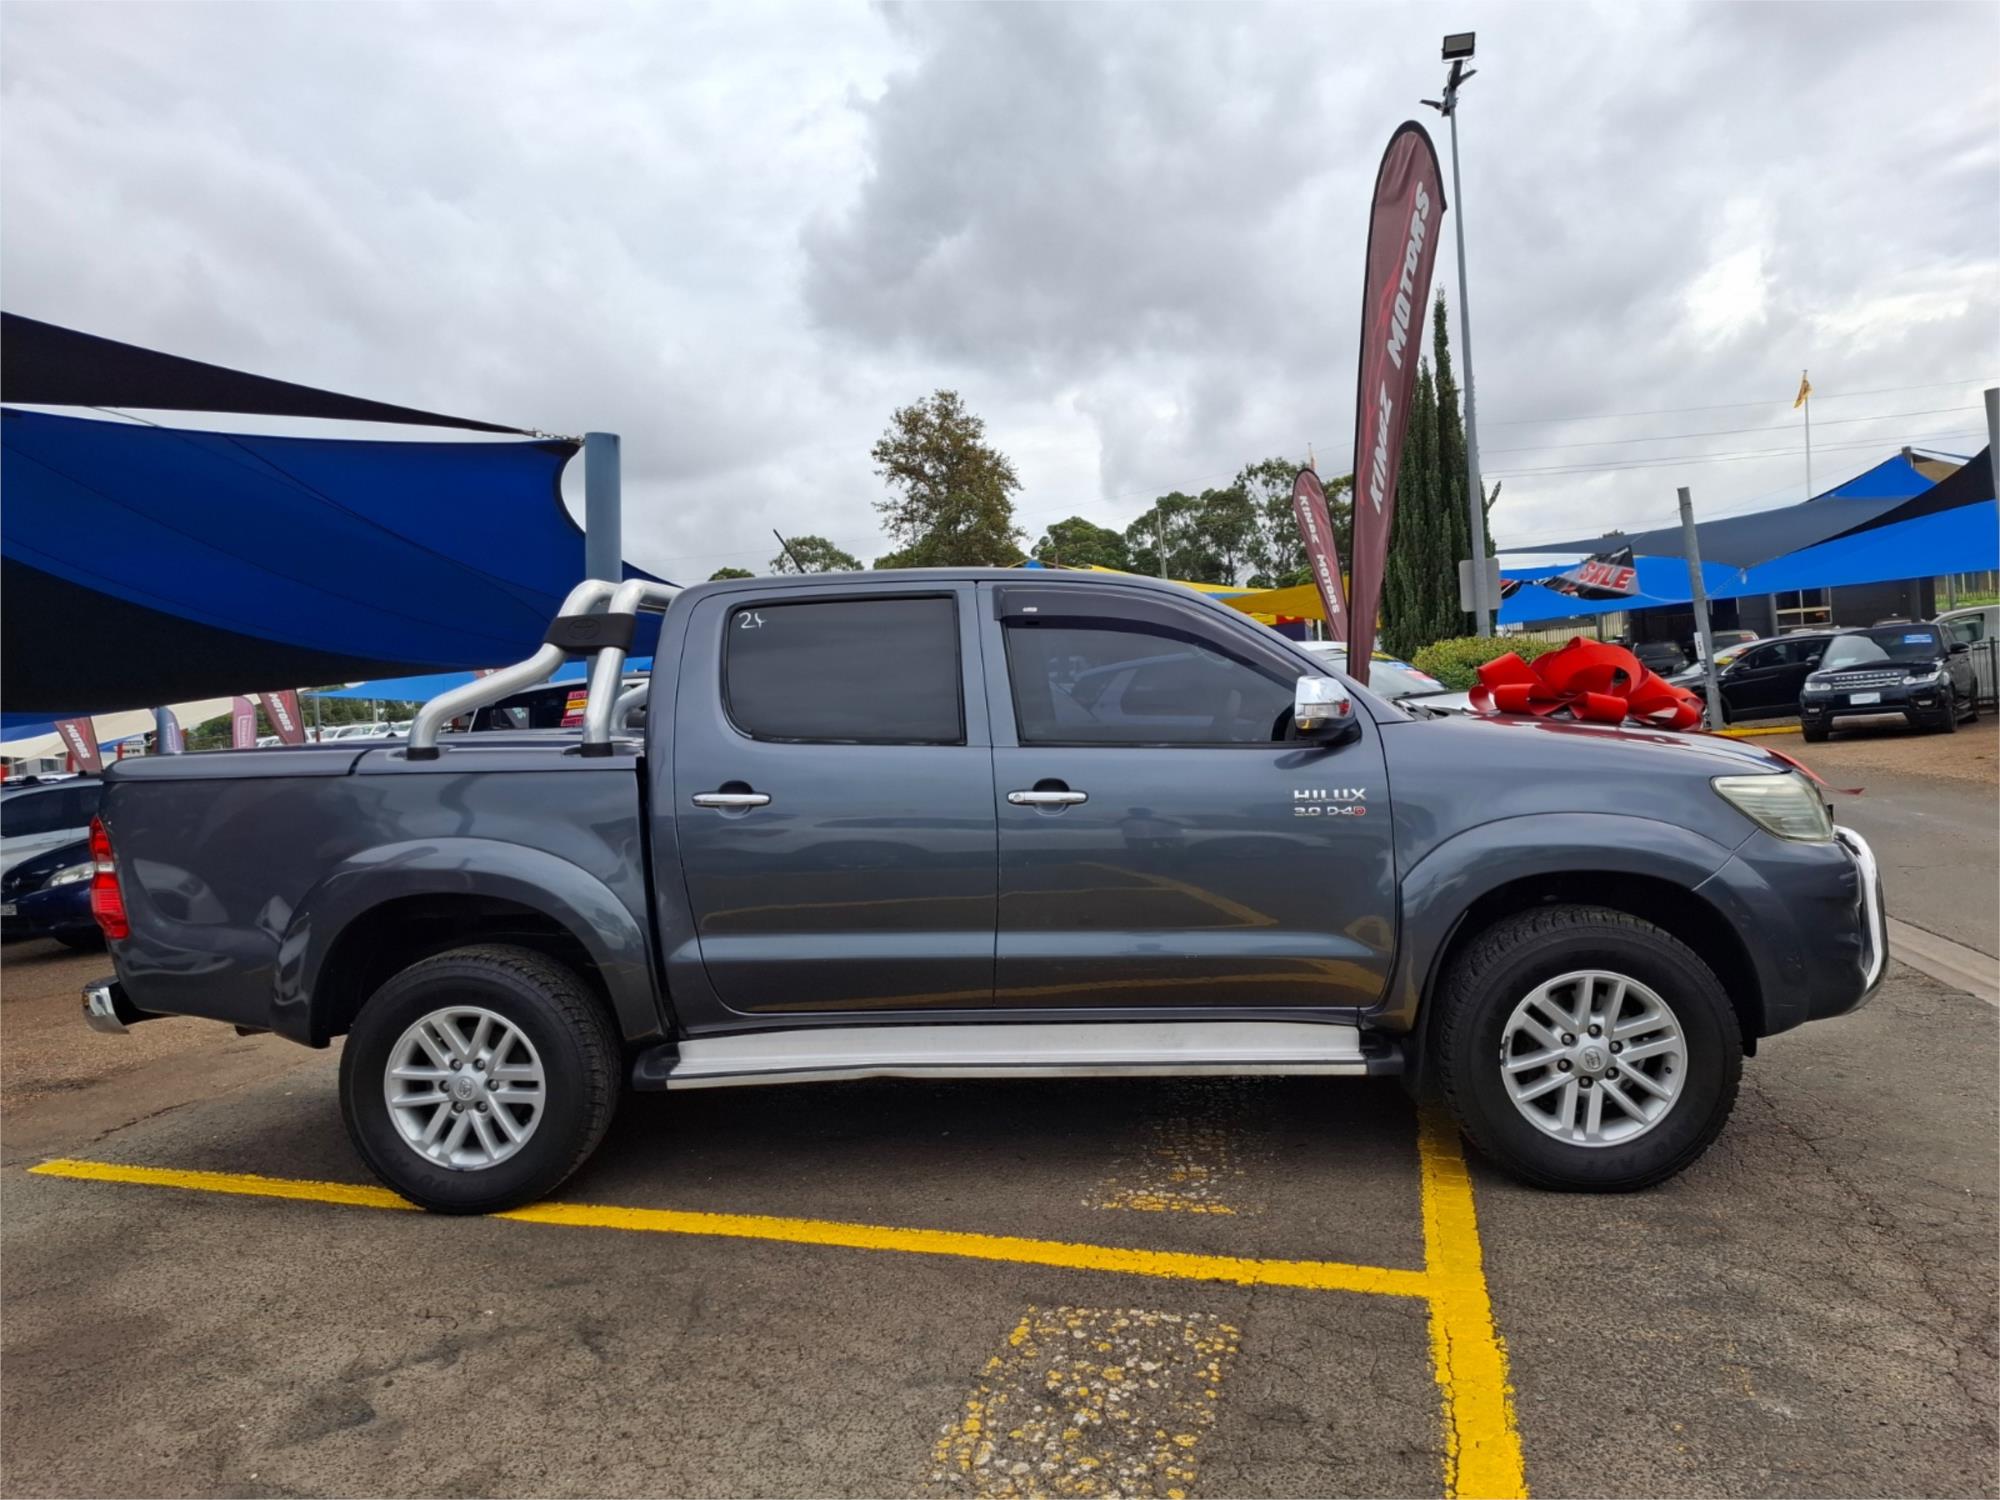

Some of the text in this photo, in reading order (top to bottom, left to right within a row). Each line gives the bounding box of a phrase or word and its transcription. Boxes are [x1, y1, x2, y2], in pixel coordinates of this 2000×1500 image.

[1370, 181, 1430, 515] KINGZ MOTORS
[1316, 553, 1341, 614] MOTORS
[1578, 559, 1637, 592] SALE
[64, 723, 92, 760] MOTORS
[1293, 787, 1367, 803] HILUX
[1326, 805, 1367, 817] D-4D
